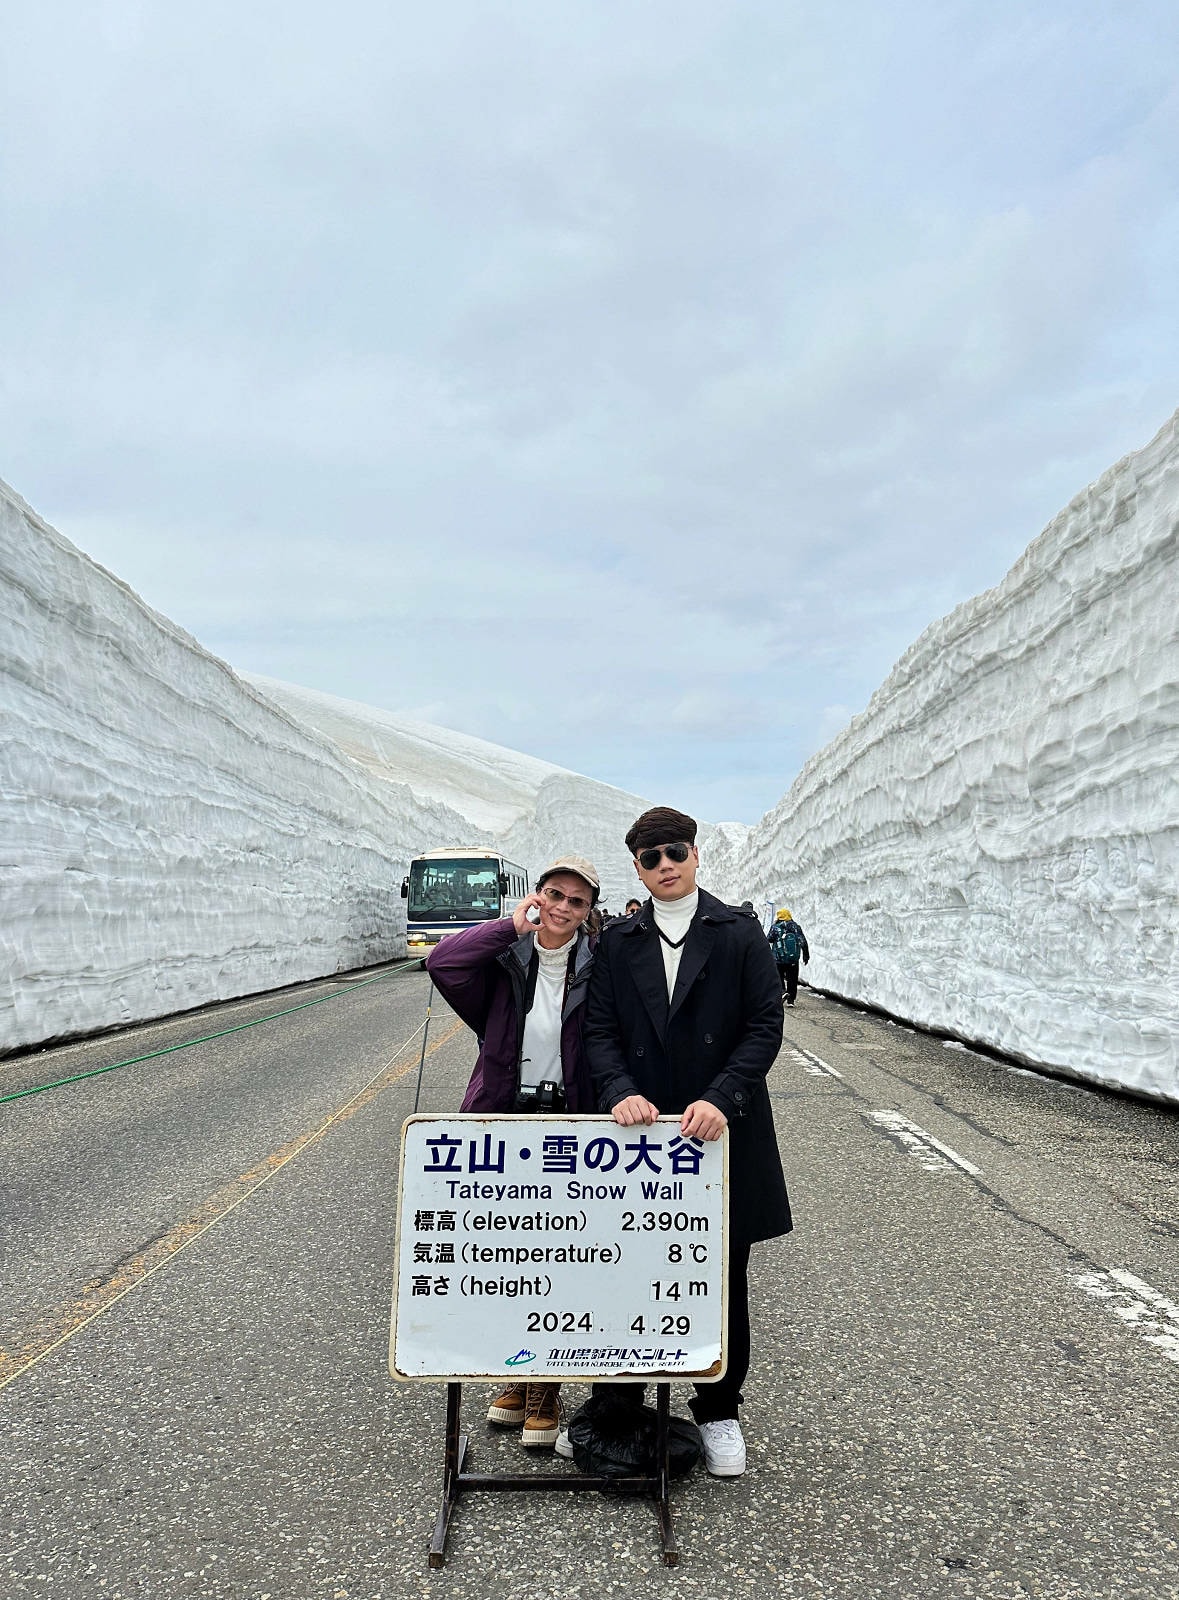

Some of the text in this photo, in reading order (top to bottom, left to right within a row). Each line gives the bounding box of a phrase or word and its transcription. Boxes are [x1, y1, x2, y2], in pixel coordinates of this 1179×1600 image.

[423, 1133, 706, 1175] 立山・雪の大谷
[446, 1180, 683, 1202] Tateyama Snow Wall
[621, 1211, 709, 1233] 2,390m
